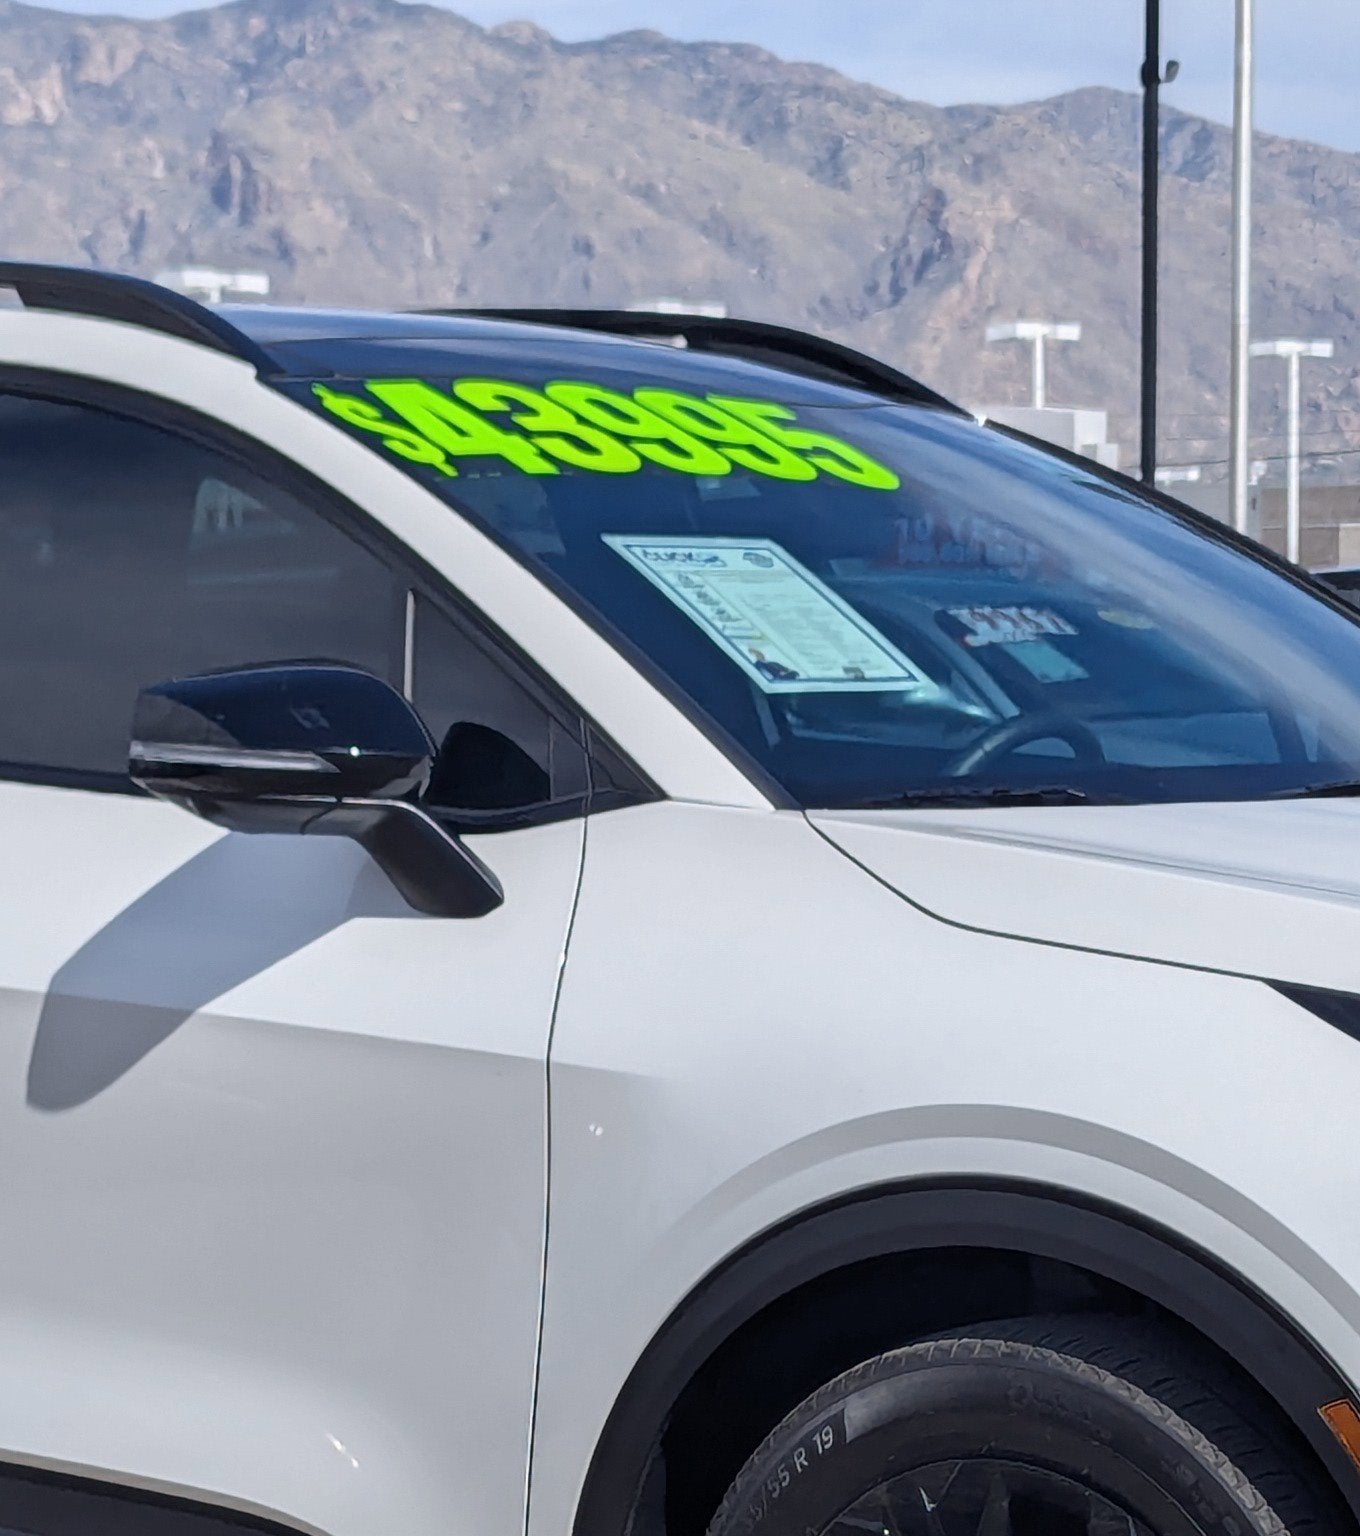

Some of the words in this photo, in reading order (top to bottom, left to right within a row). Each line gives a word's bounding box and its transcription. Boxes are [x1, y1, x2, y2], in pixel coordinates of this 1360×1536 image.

[310, 378, 901, 490] $43995
[792, 1445, 810, 1475] R
[811, 1424, 836, 1455] 19
